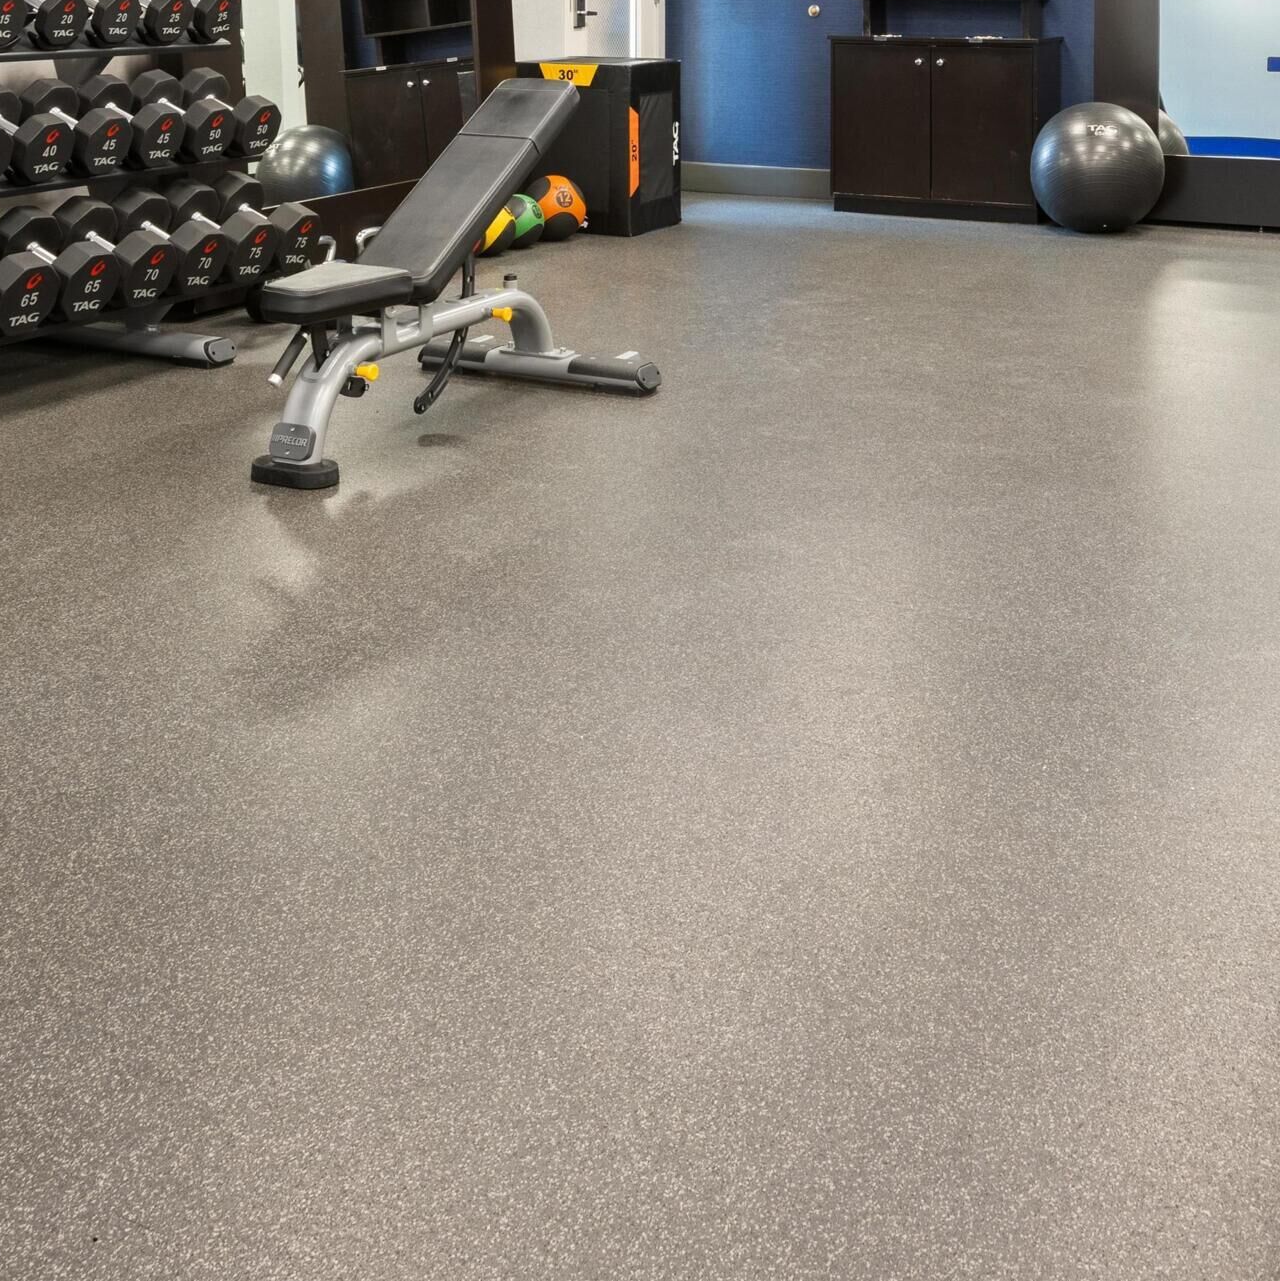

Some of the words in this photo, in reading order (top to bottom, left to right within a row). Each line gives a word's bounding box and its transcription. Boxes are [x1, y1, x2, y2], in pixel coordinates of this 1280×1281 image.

[0, 14, 12, 25] 15
[60, 14, 74, 25] 20
[115, 12, 128, 23] 20
[168, 12, 181, 23] 25
[217, 11, 228, 22] 25
[52, 28, 75, 38] TAG
[108, 27, 128, 35] TAG
[161, 26, 181, 35] TAG
[211, 23, 230, 34] TAG
[208, 128, 222, 141] 50
[256, 123, 269, 136] 50
[102, 138, 117, 151] 45
[156, 132, 171, 145] 45
[249, 138, 270, 151] TAG
[672, 121, 680, 167] TAG
[42, 144, 58, 158] 40
[148, 148, 171, 159] TAG
[201, 142, 223, 155] TAG
[93, 155, 117, 167] TAG
[33, 161, 59, 175] TAG
[558, 191, 572, 203] 12
[294, 236, 309, 249] 75
[248, 246, 263, 259] 75
[197, 256, 213, 269] 70
[285, 254, 306, 265] TAG
[144, 268, 160, 281] 70
[239, 264, 261, 276] TAG
[84, 279, 102, 294] 65
[187, 275, 210, 286] TAG
[20, 291, 40, 308] 65
[132, 287, 157, 299] TAG
[72, 299, 101, 312] TAG
[8, 311, 40, 327] TAG
[278, 434, 308, 447] PRECOR
